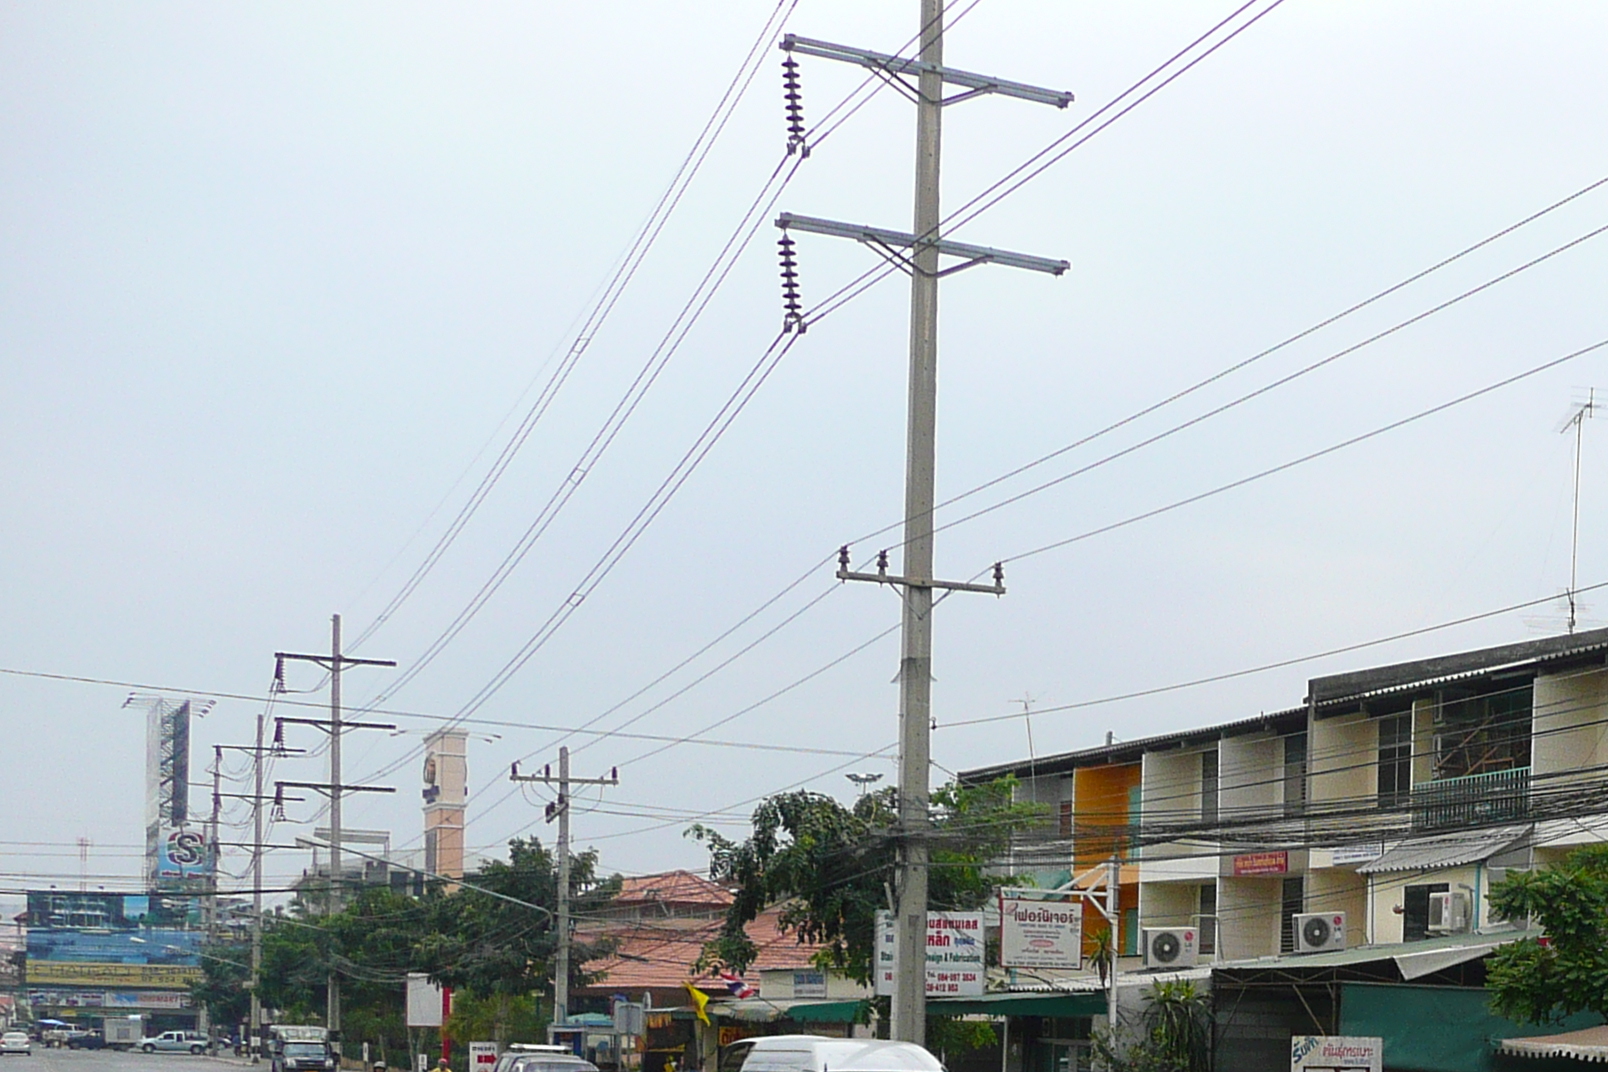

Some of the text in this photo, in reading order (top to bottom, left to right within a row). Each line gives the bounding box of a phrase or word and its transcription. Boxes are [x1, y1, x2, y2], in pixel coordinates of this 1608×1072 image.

[1014, 907, 1075, 924] เฟอร์นิเจอร์
[926, 917, 979, 931] นสแตนเลส
[927, 930, 950, 947] หล็ก
[949, 951, 981, 962] Fabrication
